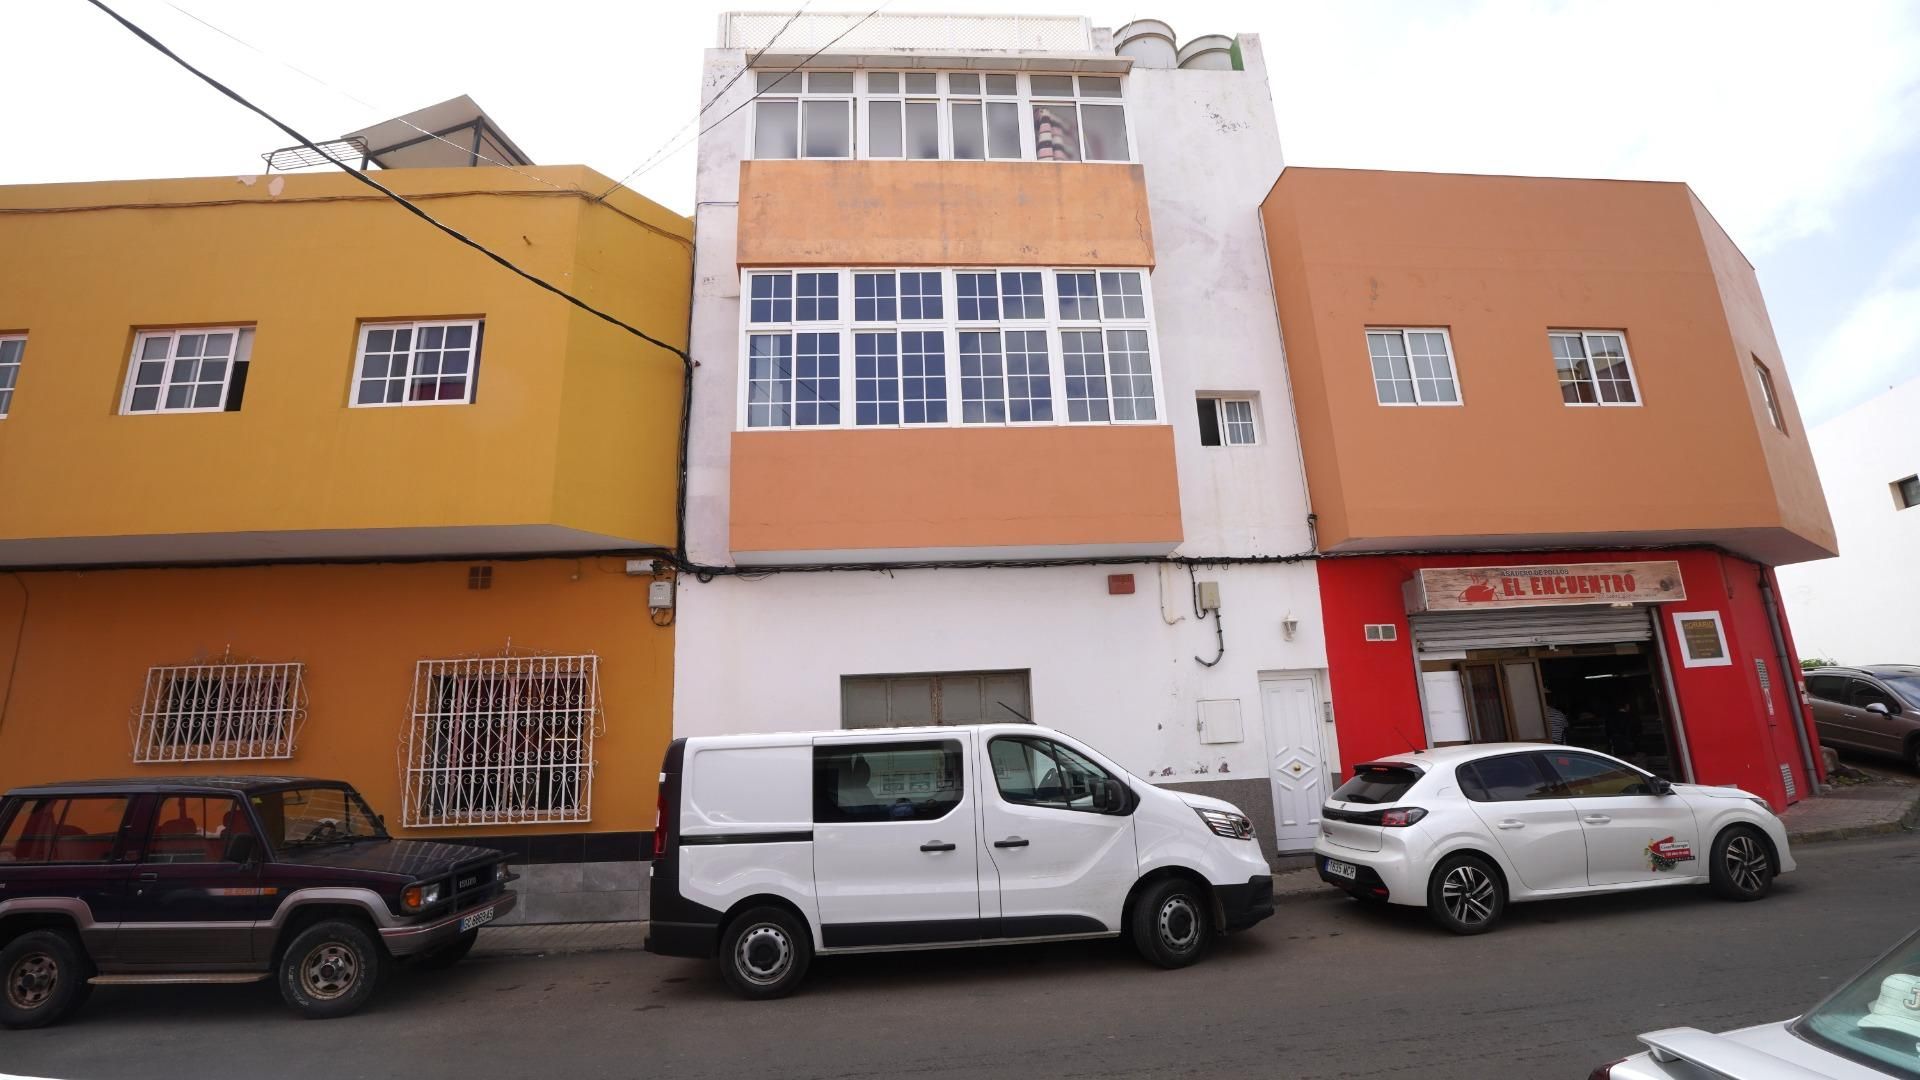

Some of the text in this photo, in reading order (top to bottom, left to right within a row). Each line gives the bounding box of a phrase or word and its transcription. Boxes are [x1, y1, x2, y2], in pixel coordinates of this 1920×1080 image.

[1501, 569, 1532, 577] ASADERO
[1543, 568, 1569, 576] POLLOS
[1501, 574, 1636, 597] EL ENCUENTRO
